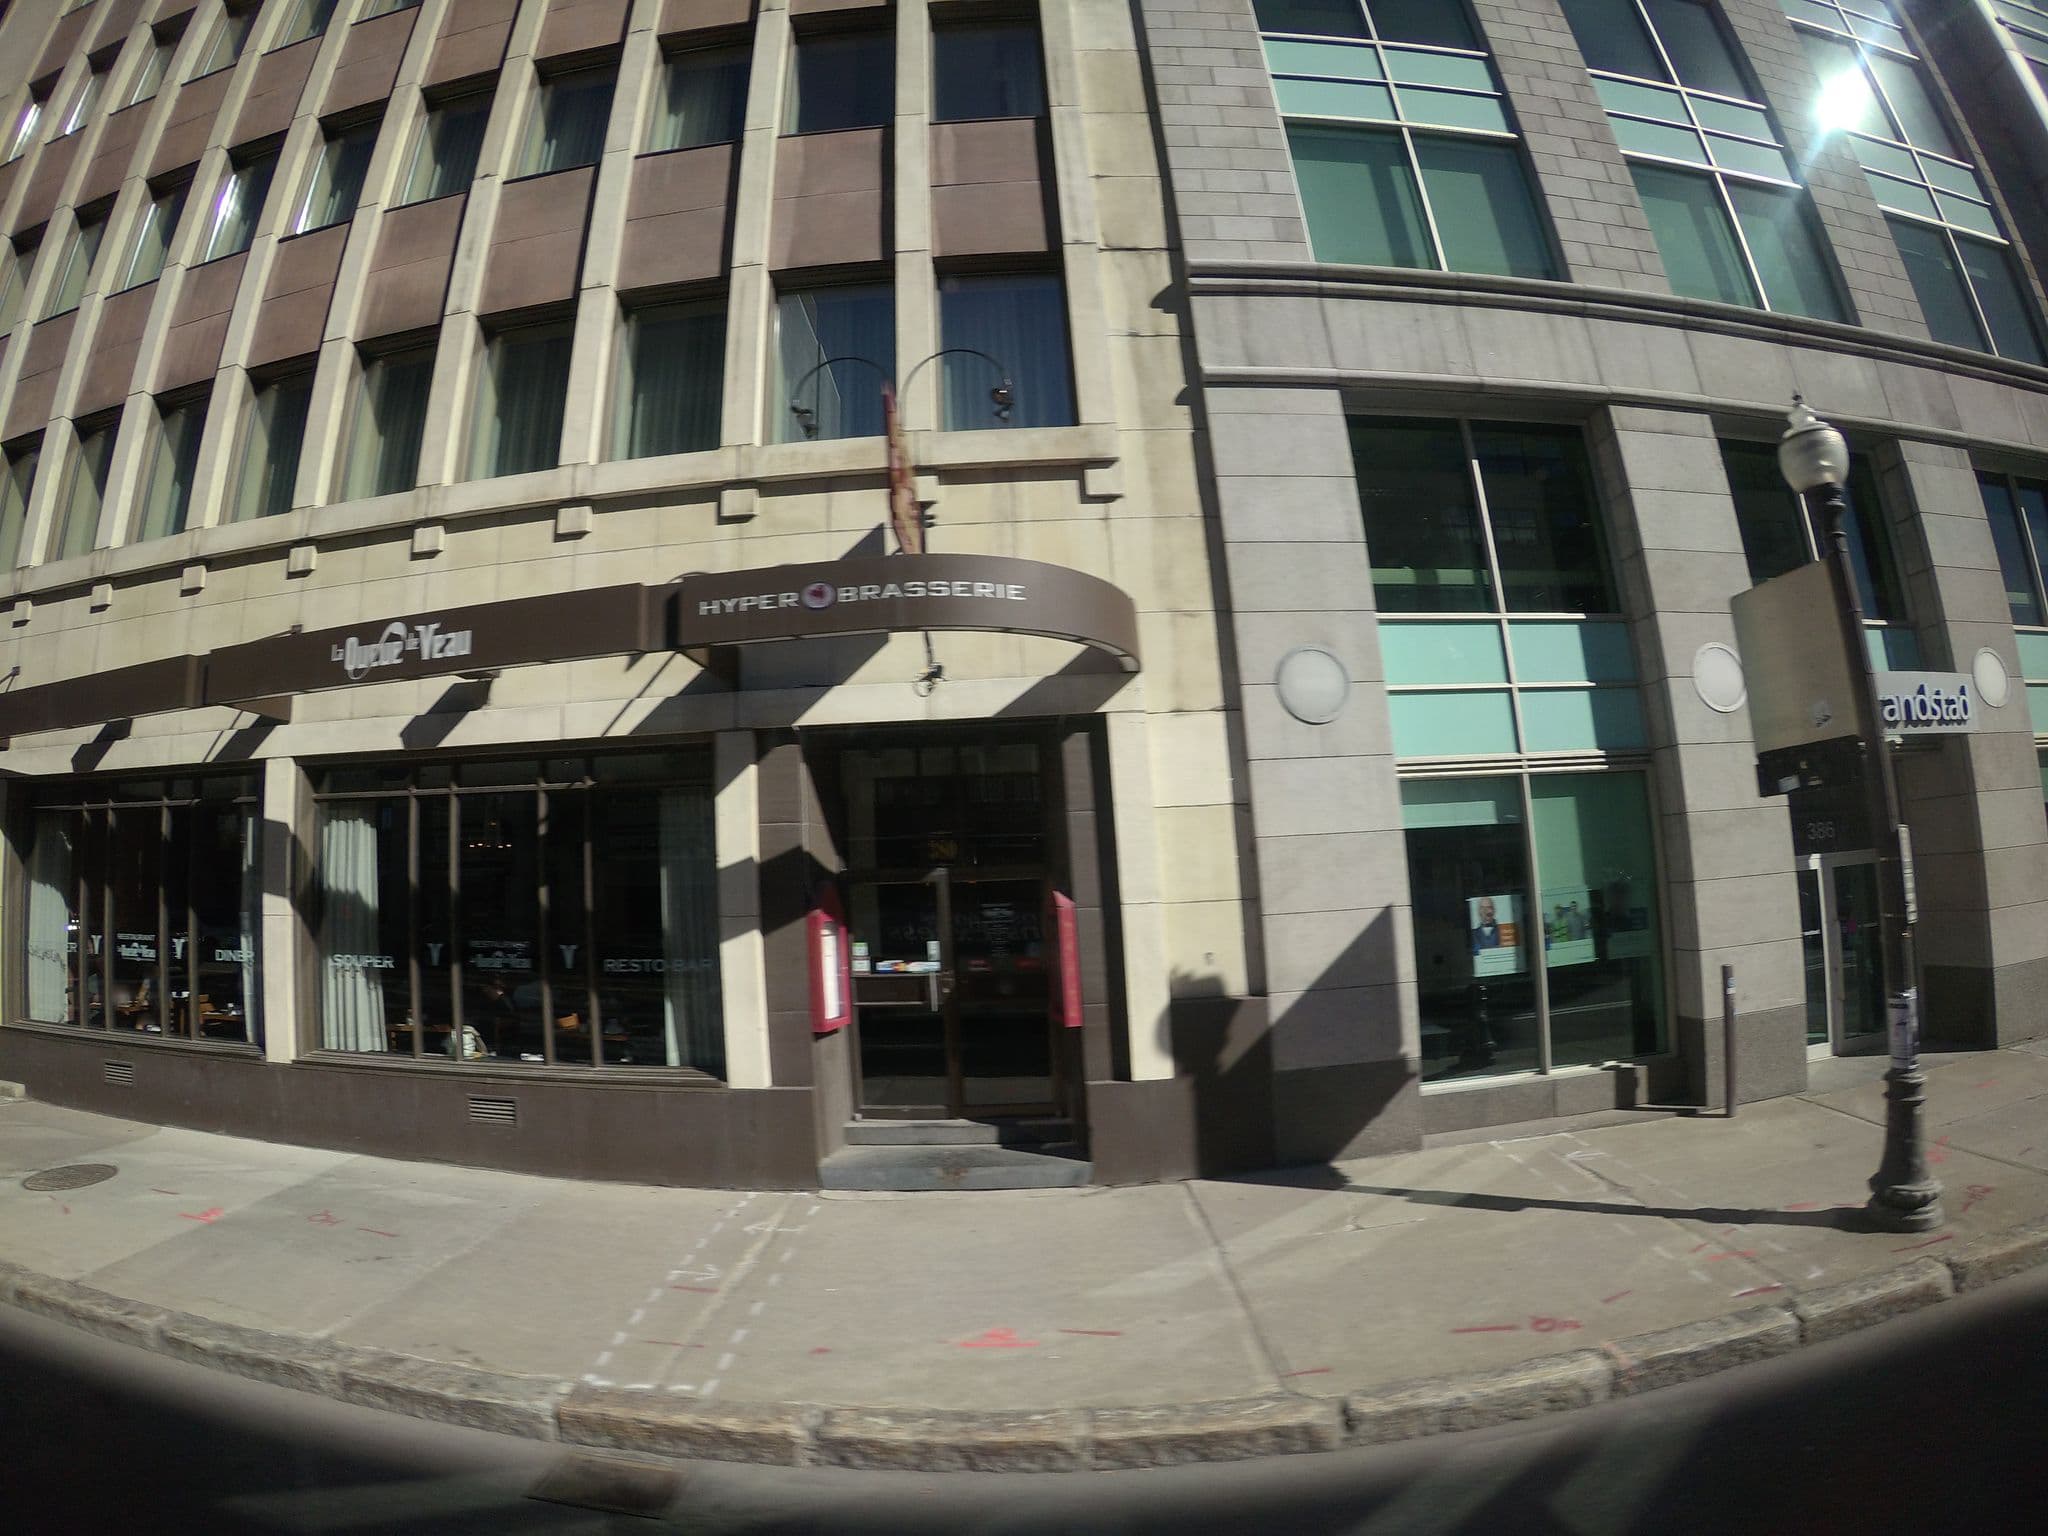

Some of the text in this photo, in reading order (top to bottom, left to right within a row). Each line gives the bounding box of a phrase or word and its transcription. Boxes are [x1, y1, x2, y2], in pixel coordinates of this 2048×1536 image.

[698, 580, 1027, 616] HYPER BRASSERIE
[1880, 683, 1970, 723] andstad
[331, 953, 395, 968] SOUPER
